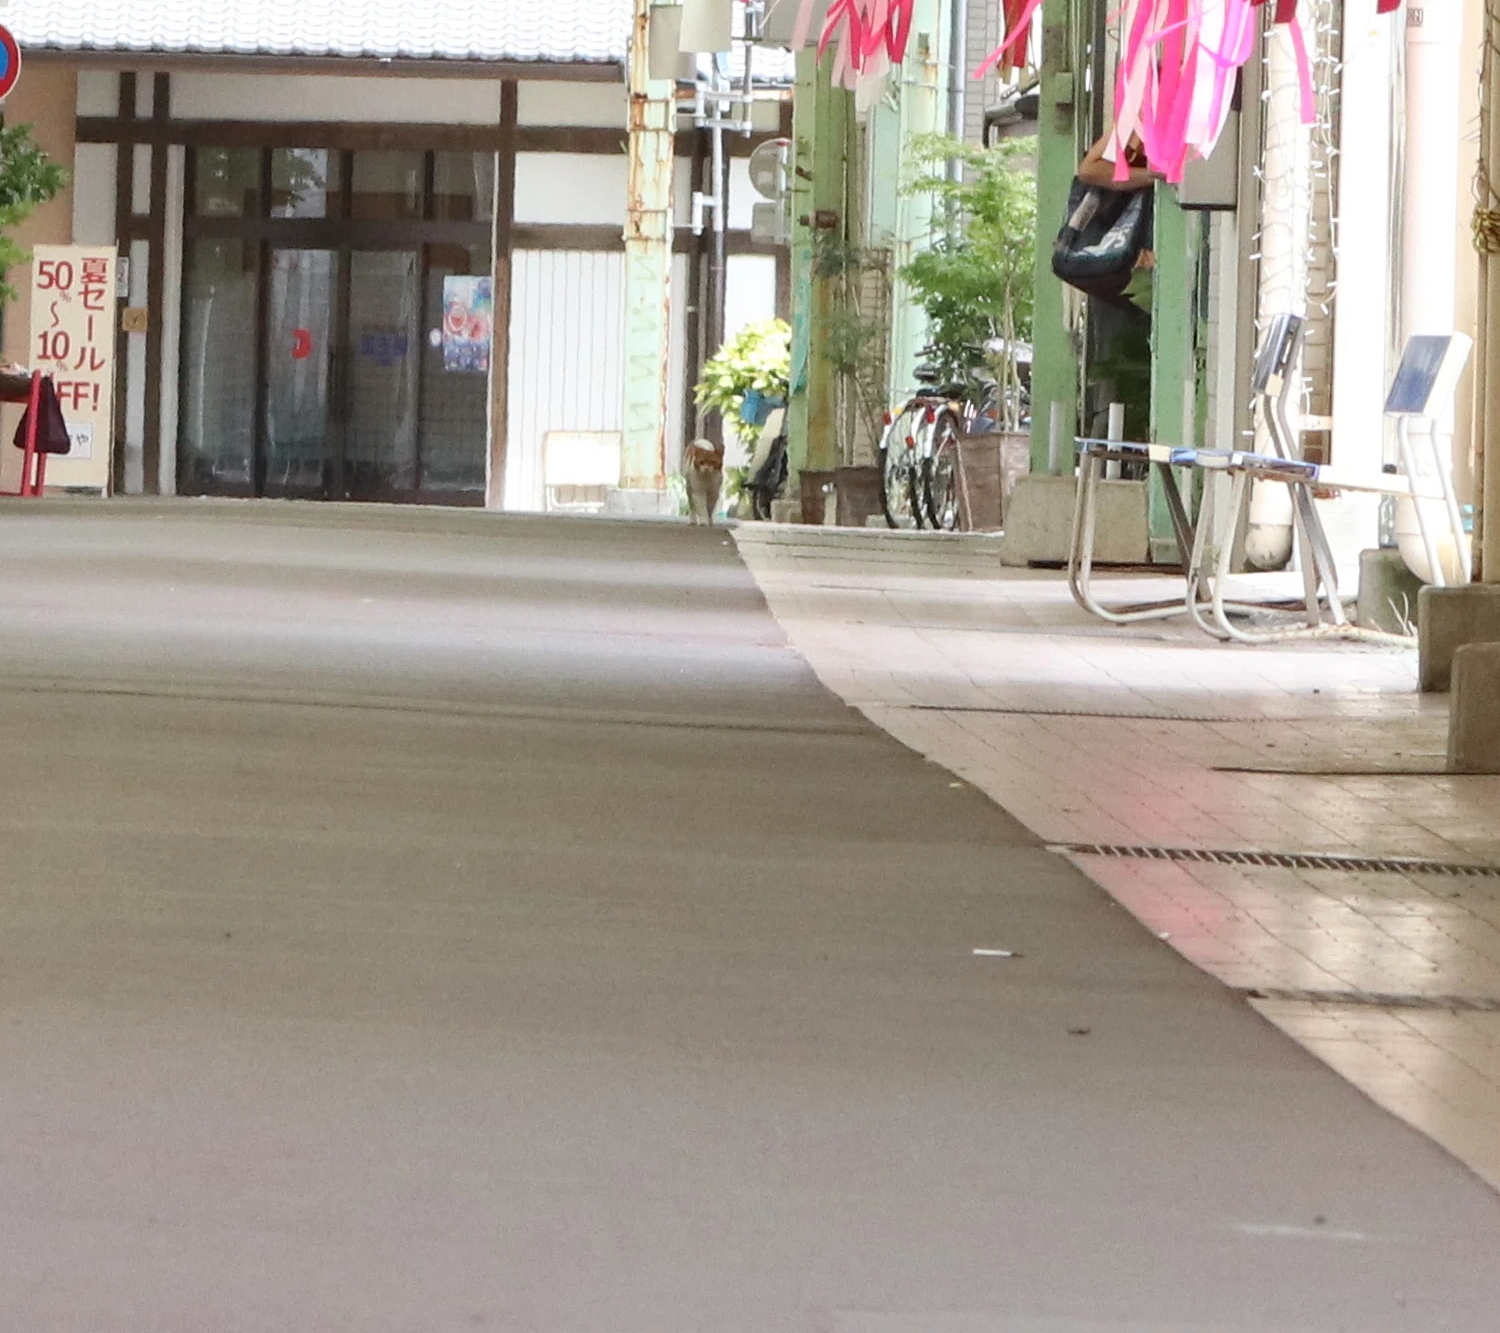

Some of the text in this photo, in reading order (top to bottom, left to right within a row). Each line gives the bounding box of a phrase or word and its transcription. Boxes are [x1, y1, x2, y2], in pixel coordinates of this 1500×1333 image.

[73, 256, 110, 372] 夏セール
[54, 380, 100, 412] FF!
